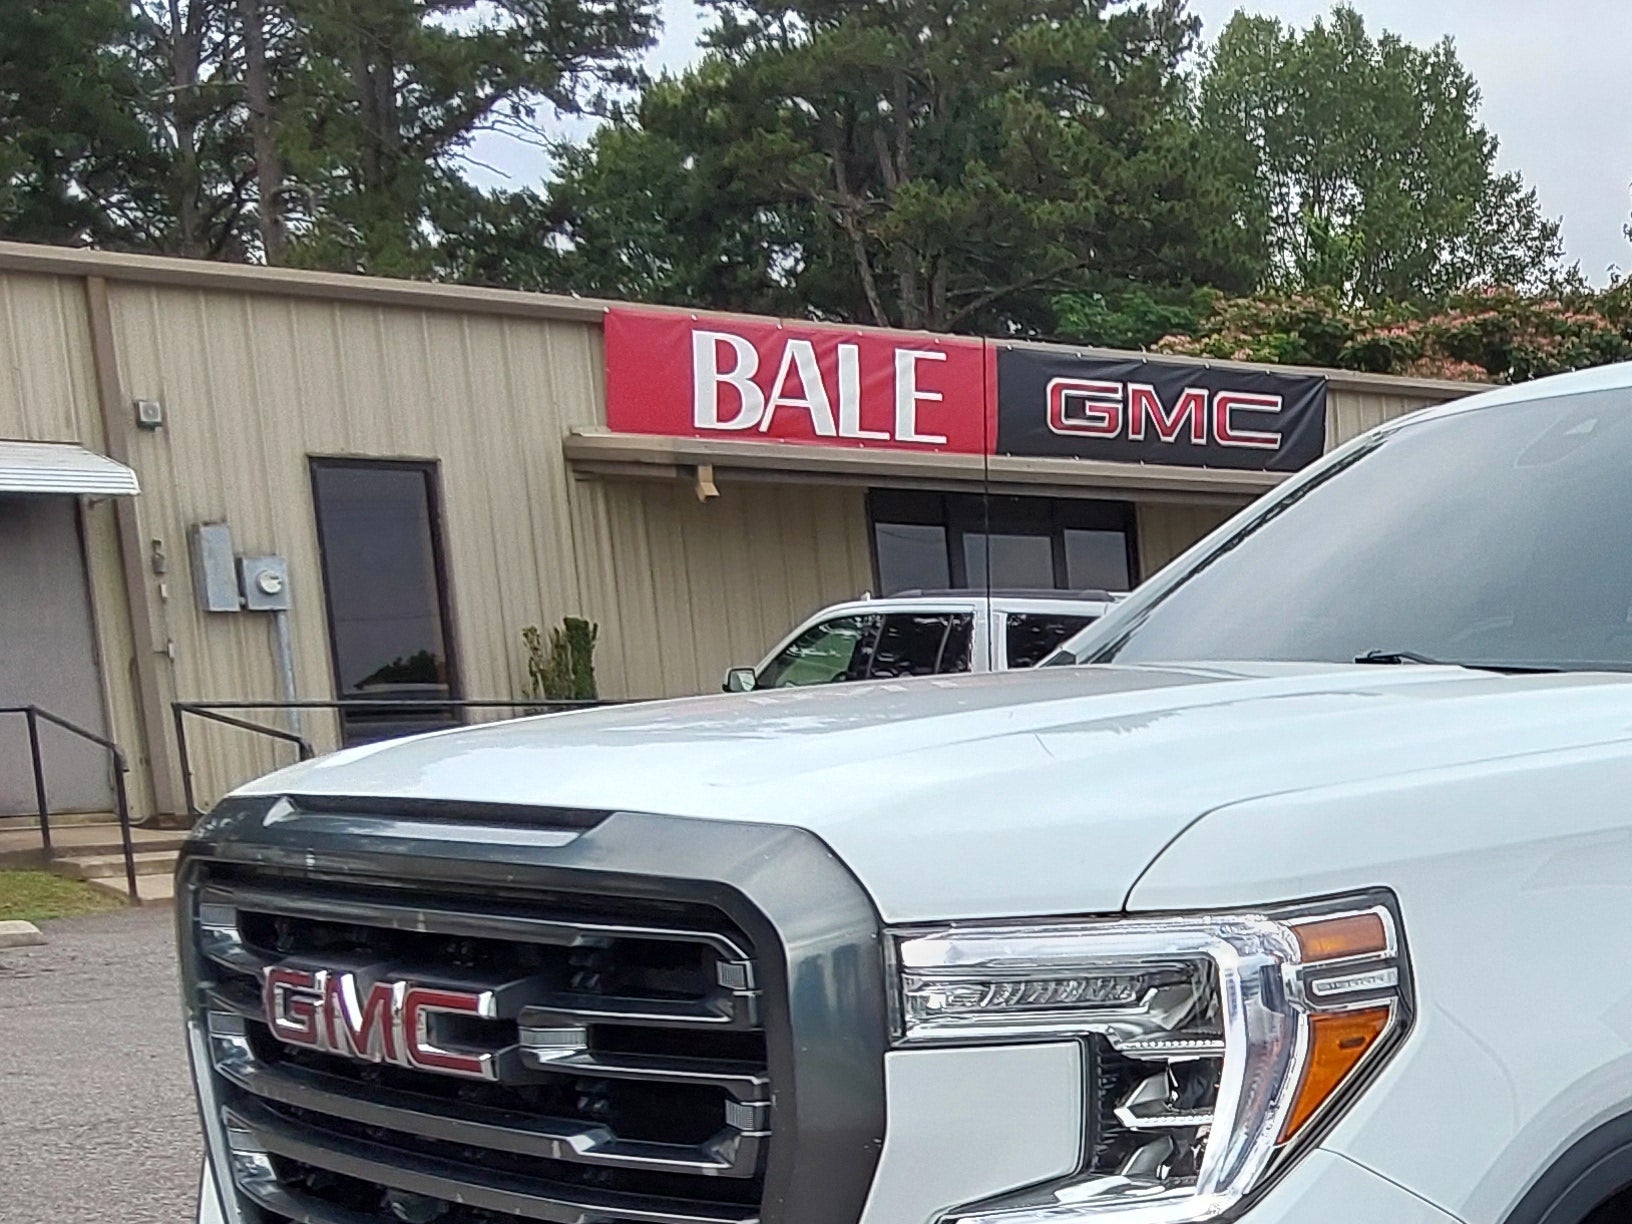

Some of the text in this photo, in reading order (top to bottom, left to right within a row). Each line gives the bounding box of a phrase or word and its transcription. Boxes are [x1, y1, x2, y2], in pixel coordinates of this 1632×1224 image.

[691, 330, 948, 446] BALE
[1045, 376, 1285, 451] GMC
[263, 966, 499, 1082] GMC
